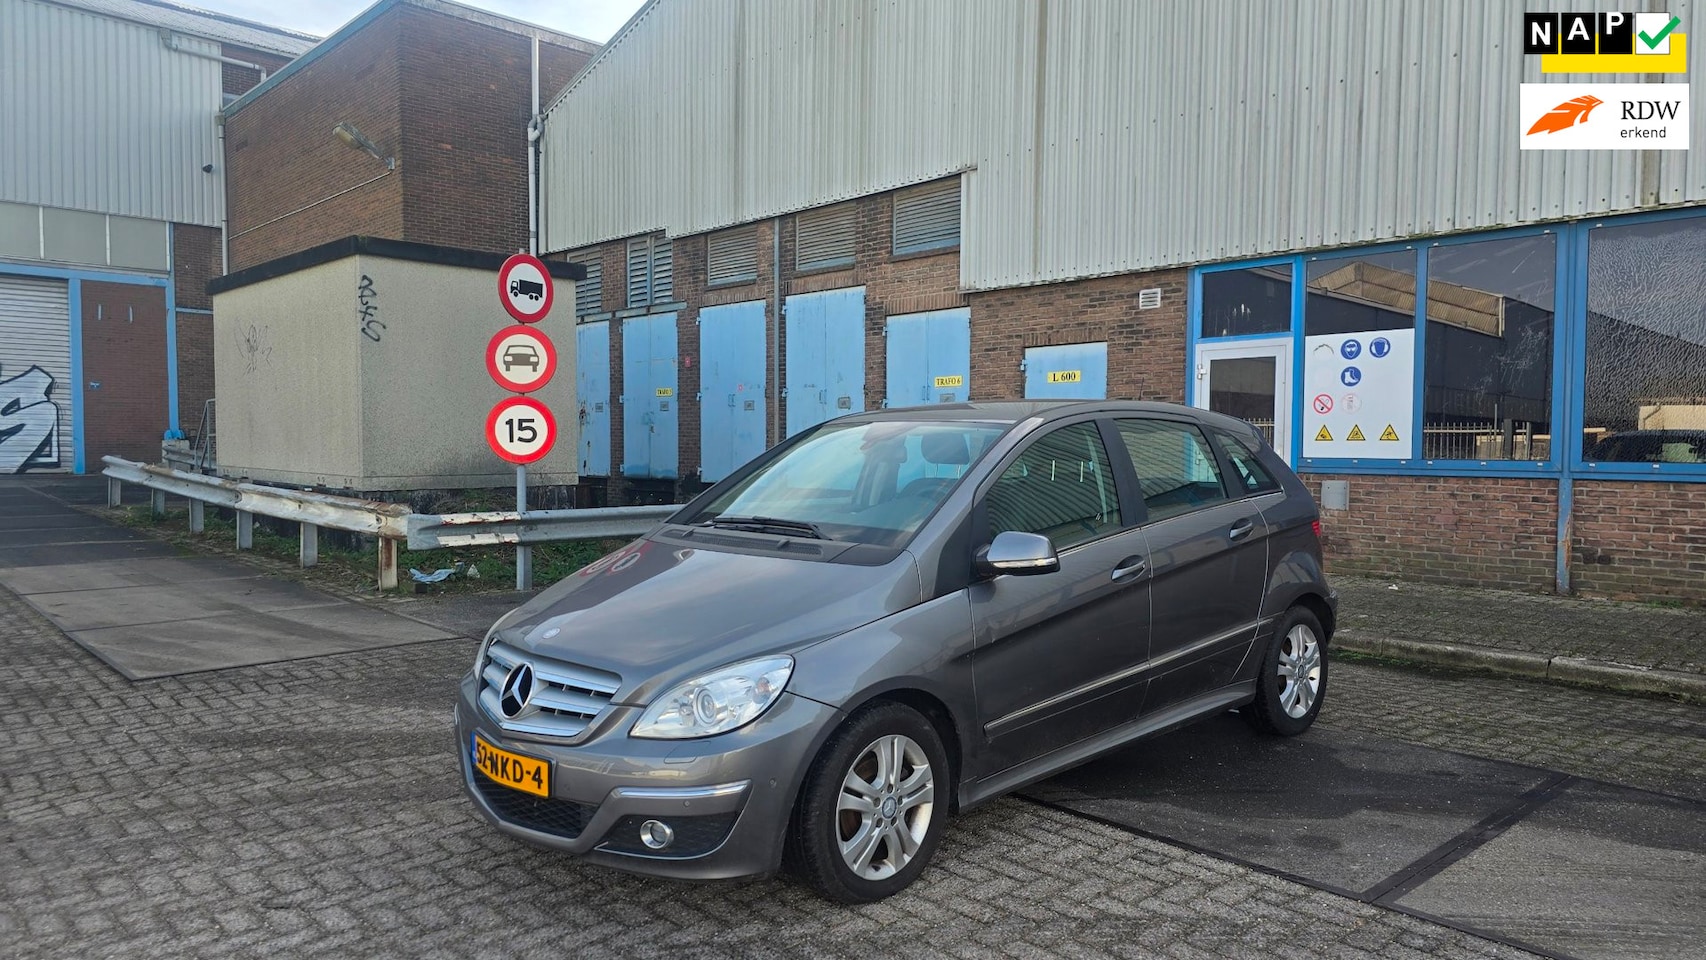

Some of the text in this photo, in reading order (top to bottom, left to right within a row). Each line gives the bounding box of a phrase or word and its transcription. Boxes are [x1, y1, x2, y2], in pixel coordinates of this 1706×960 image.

[936, 377, 957, 386] TRAFO
[1053, 371, 1076, 382] L 600
[505, 418, 538, 443] 15
[476, 741, 543, 790] 52-NKD-4
